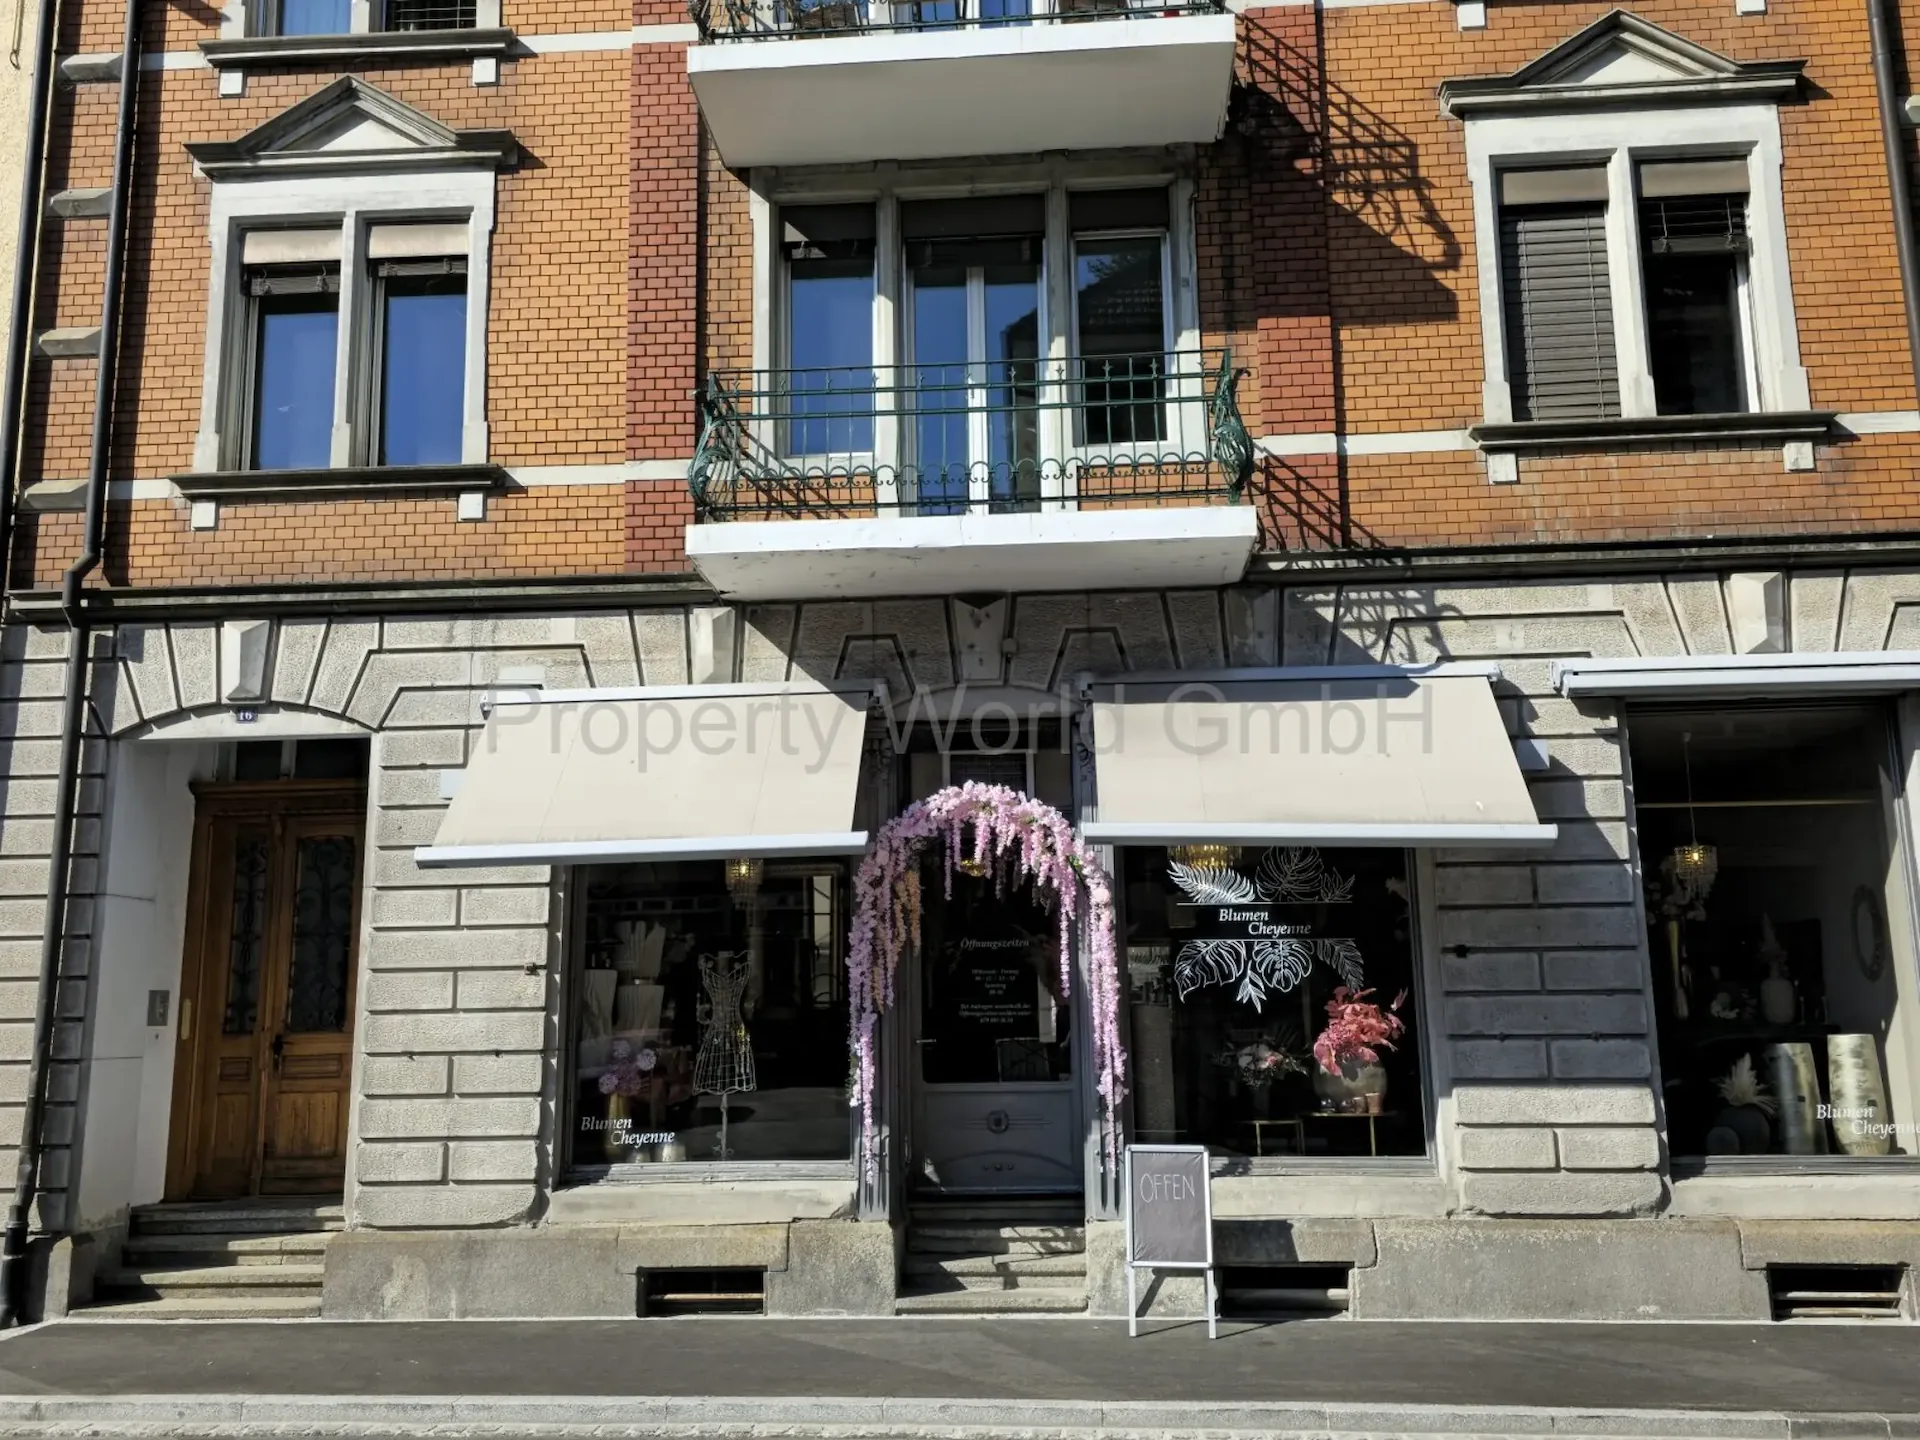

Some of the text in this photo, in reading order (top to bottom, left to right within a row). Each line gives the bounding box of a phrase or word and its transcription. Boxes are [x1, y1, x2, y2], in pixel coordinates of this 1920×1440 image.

[240, 711, 253, 721] 16
[1219, 908, 1269, 922] Blumen
[1248, 922, 1312, 939] Cheyenne
[960, 936, 1030, 951] Öffnungszeiten
[1816, 1104, 1874, 1119] Blumen
[581, 1116, 632, 1131] Blumen
[611, 1130, 676, 1149] Cheyenne
[1140, 1172, 1196, 1203] OFFEN
